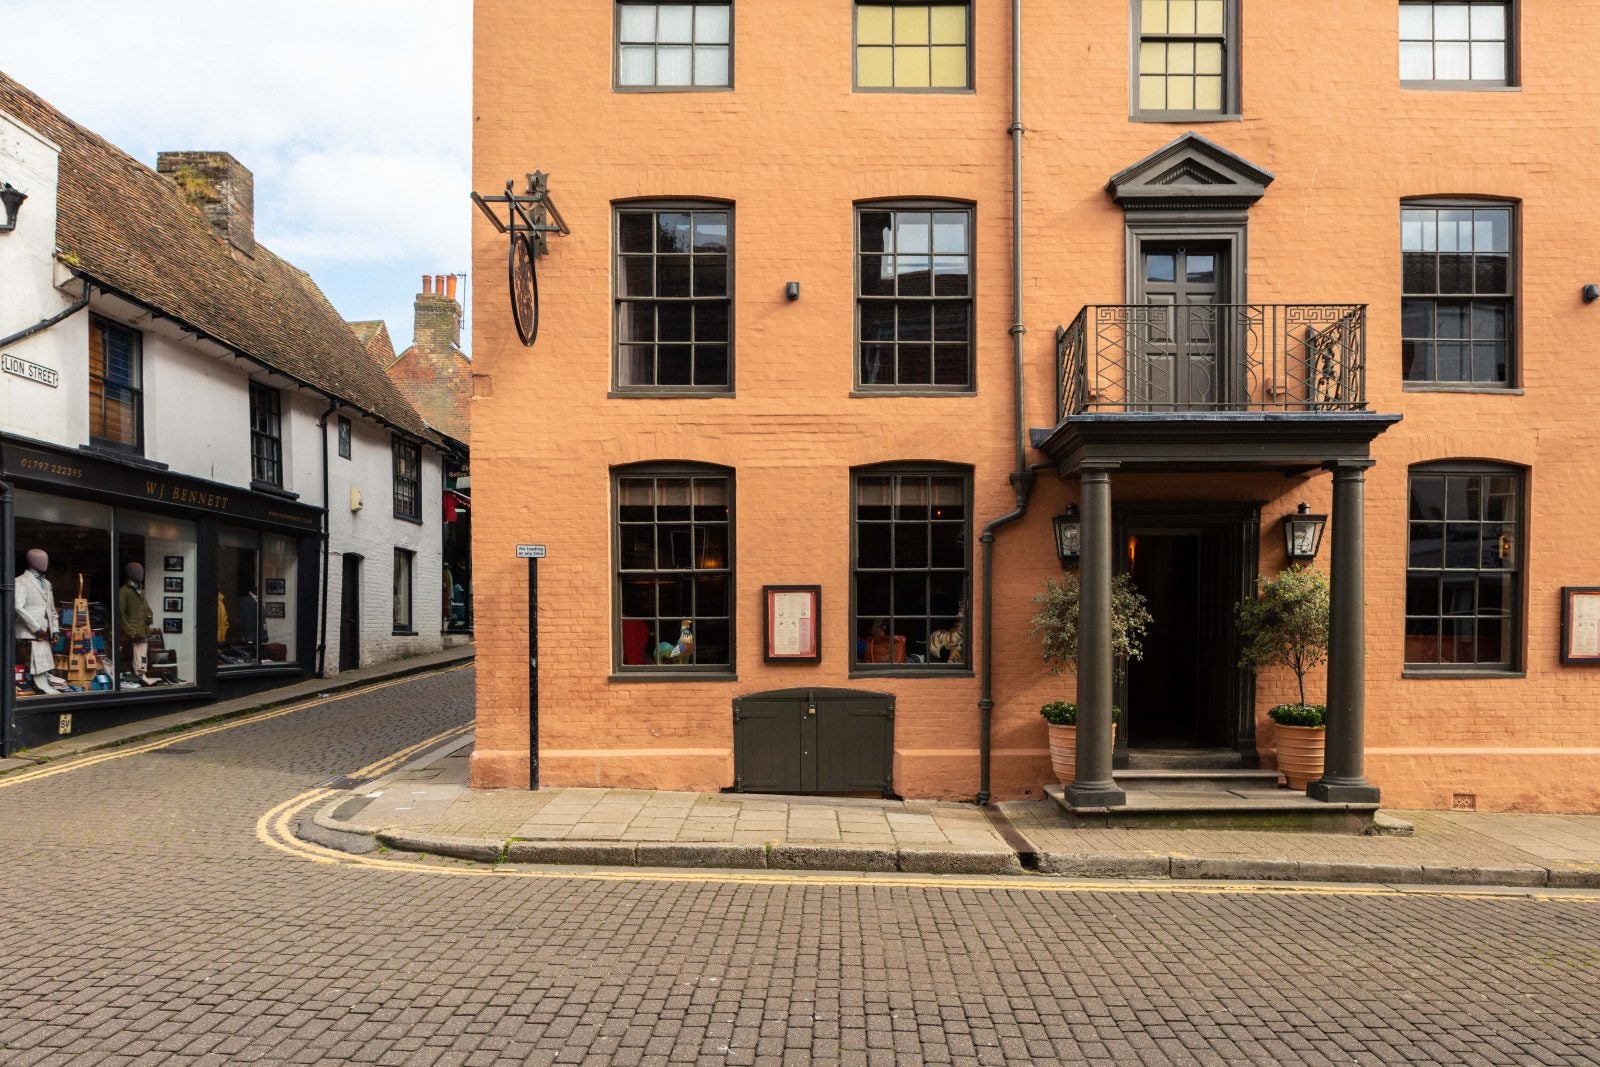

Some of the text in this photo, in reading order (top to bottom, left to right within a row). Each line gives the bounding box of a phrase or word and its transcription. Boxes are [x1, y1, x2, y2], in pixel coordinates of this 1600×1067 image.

[5, 356, 56, 384] LION STREET
[21, 458, 82, 478] 01797 222395
[172, 487, 229, 508] BENNETT
[61, 719, 70, 728] SV
